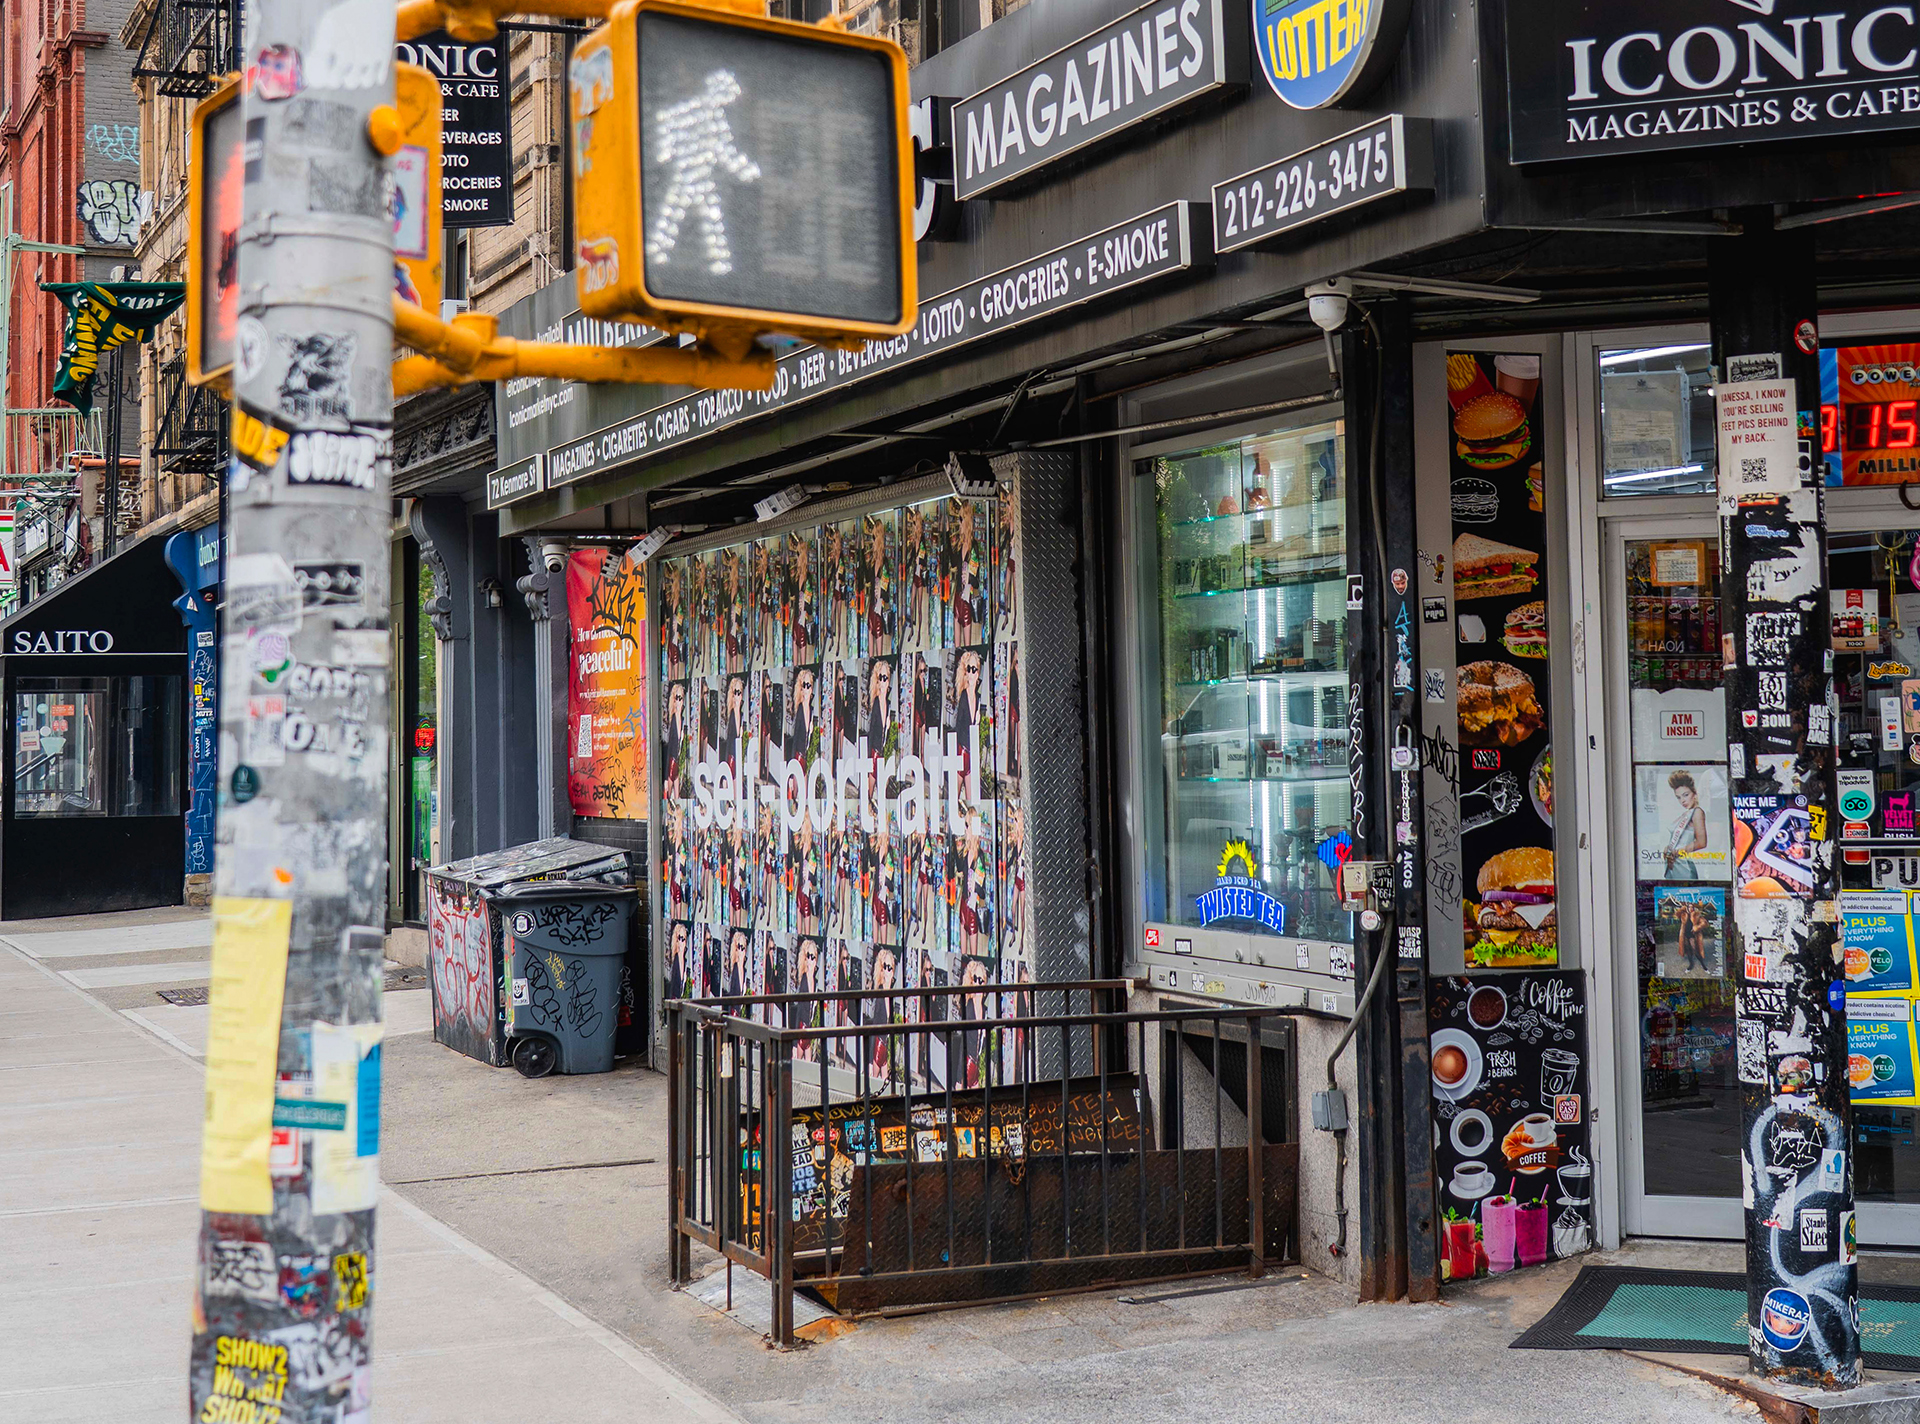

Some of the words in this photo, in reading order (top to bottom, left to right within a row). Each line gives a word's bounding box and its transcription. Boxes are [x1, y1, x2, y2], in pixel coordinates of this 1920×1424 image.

[1565, 7, 1918, 101] ICONIC
[441, 84, 453, 96] &
[457, 83, 500, 98] CAFE
[966, 1, 1204, 179] MAGAZINES
[1566, 99, 1780, 143] MAGAZINES
[1790, 97, 1816, 123] &
[1826, 86, 1920, 119] CAFE
[440, 131, 502, 145] EVERAGES
[440, 154, 469, 167] OTTO
[441, 176, 502, 190] ROCERIES
[1224, 132, 1388, 238] 212-226-3475
[440, 198, 489, 212] -SMOKE
[553, 440, 595, 480] MAGAZINES
[602, 421, 648, 461] CIGARETTES
[656, 405, 690, 442] CIGARS
[698, 388, 743, 427] TOBACCO
[800, 352, 826, 390] BEER
[922, 304, 966, 347] LOTTO
[980, 257, 1070, 323] GROCERIES
[1088, 219, 1169, 285] E-SMOKE
[1853, 369, 1916, 384] POWE
[1761, 389, 1786, 399] KNOW
[1723, 404, 1747, 417] YOU'RE
[1750, 403, 1784, 414] SELLING
[1721, 421, 1735, 431] FEET
[1738, 419, 1755, 430] PICS
[1758, 417, 1788, 428] BEHIND
[1731, 435, 1742, 445] MY
[1858, 457, 1920, 474] MILLI
[491, 479, 500, 500] 72
[500, 472, 528, 496] Kenmare
[529, 463, 536, 490] St
[14, 630, 114, 654] SAITO
[579, 639, 633, 683] peaceful?
[1671, 713, 1692, 725] ATM
[1666, 726, 1698, 737] INSIDE
[694, 725, 981, 854] self-portrait!
[1732, 796, 1756, 808] TAKE
[1758, 796, 1777, 808] ME
[1734, 808, 1764, 819] HOME.
[1884, 809, 1914, 819] VELVET
[1885, 818, 1914, 828] LLAMA
[1196, 886, 1255, 927] TWISTED
[1256, 891, 1286, 935] TEA
[1851, 916, 1887, 927] PLUS
[1398, 926, 1421, 939] WASP
[1843, 926, 1894, 935] EVERYTHING
[1847, 934, 1875, 942] KNOW
[1398, 945, 1422, 959] SEPIA
[1746, 964, 1766, 980] MATE
[1530, 978, 1574, 1014] Coffee
[1854, 1023, 1889, 1034] PLUS
[1492, 1067, 1514, 1078] BEANS
[1559, 1105, 1576, 1113] EAST
[1859, 1124, 1912, 1134] TORCH
[1519, 1152, 1547, 1166] COFFEE
